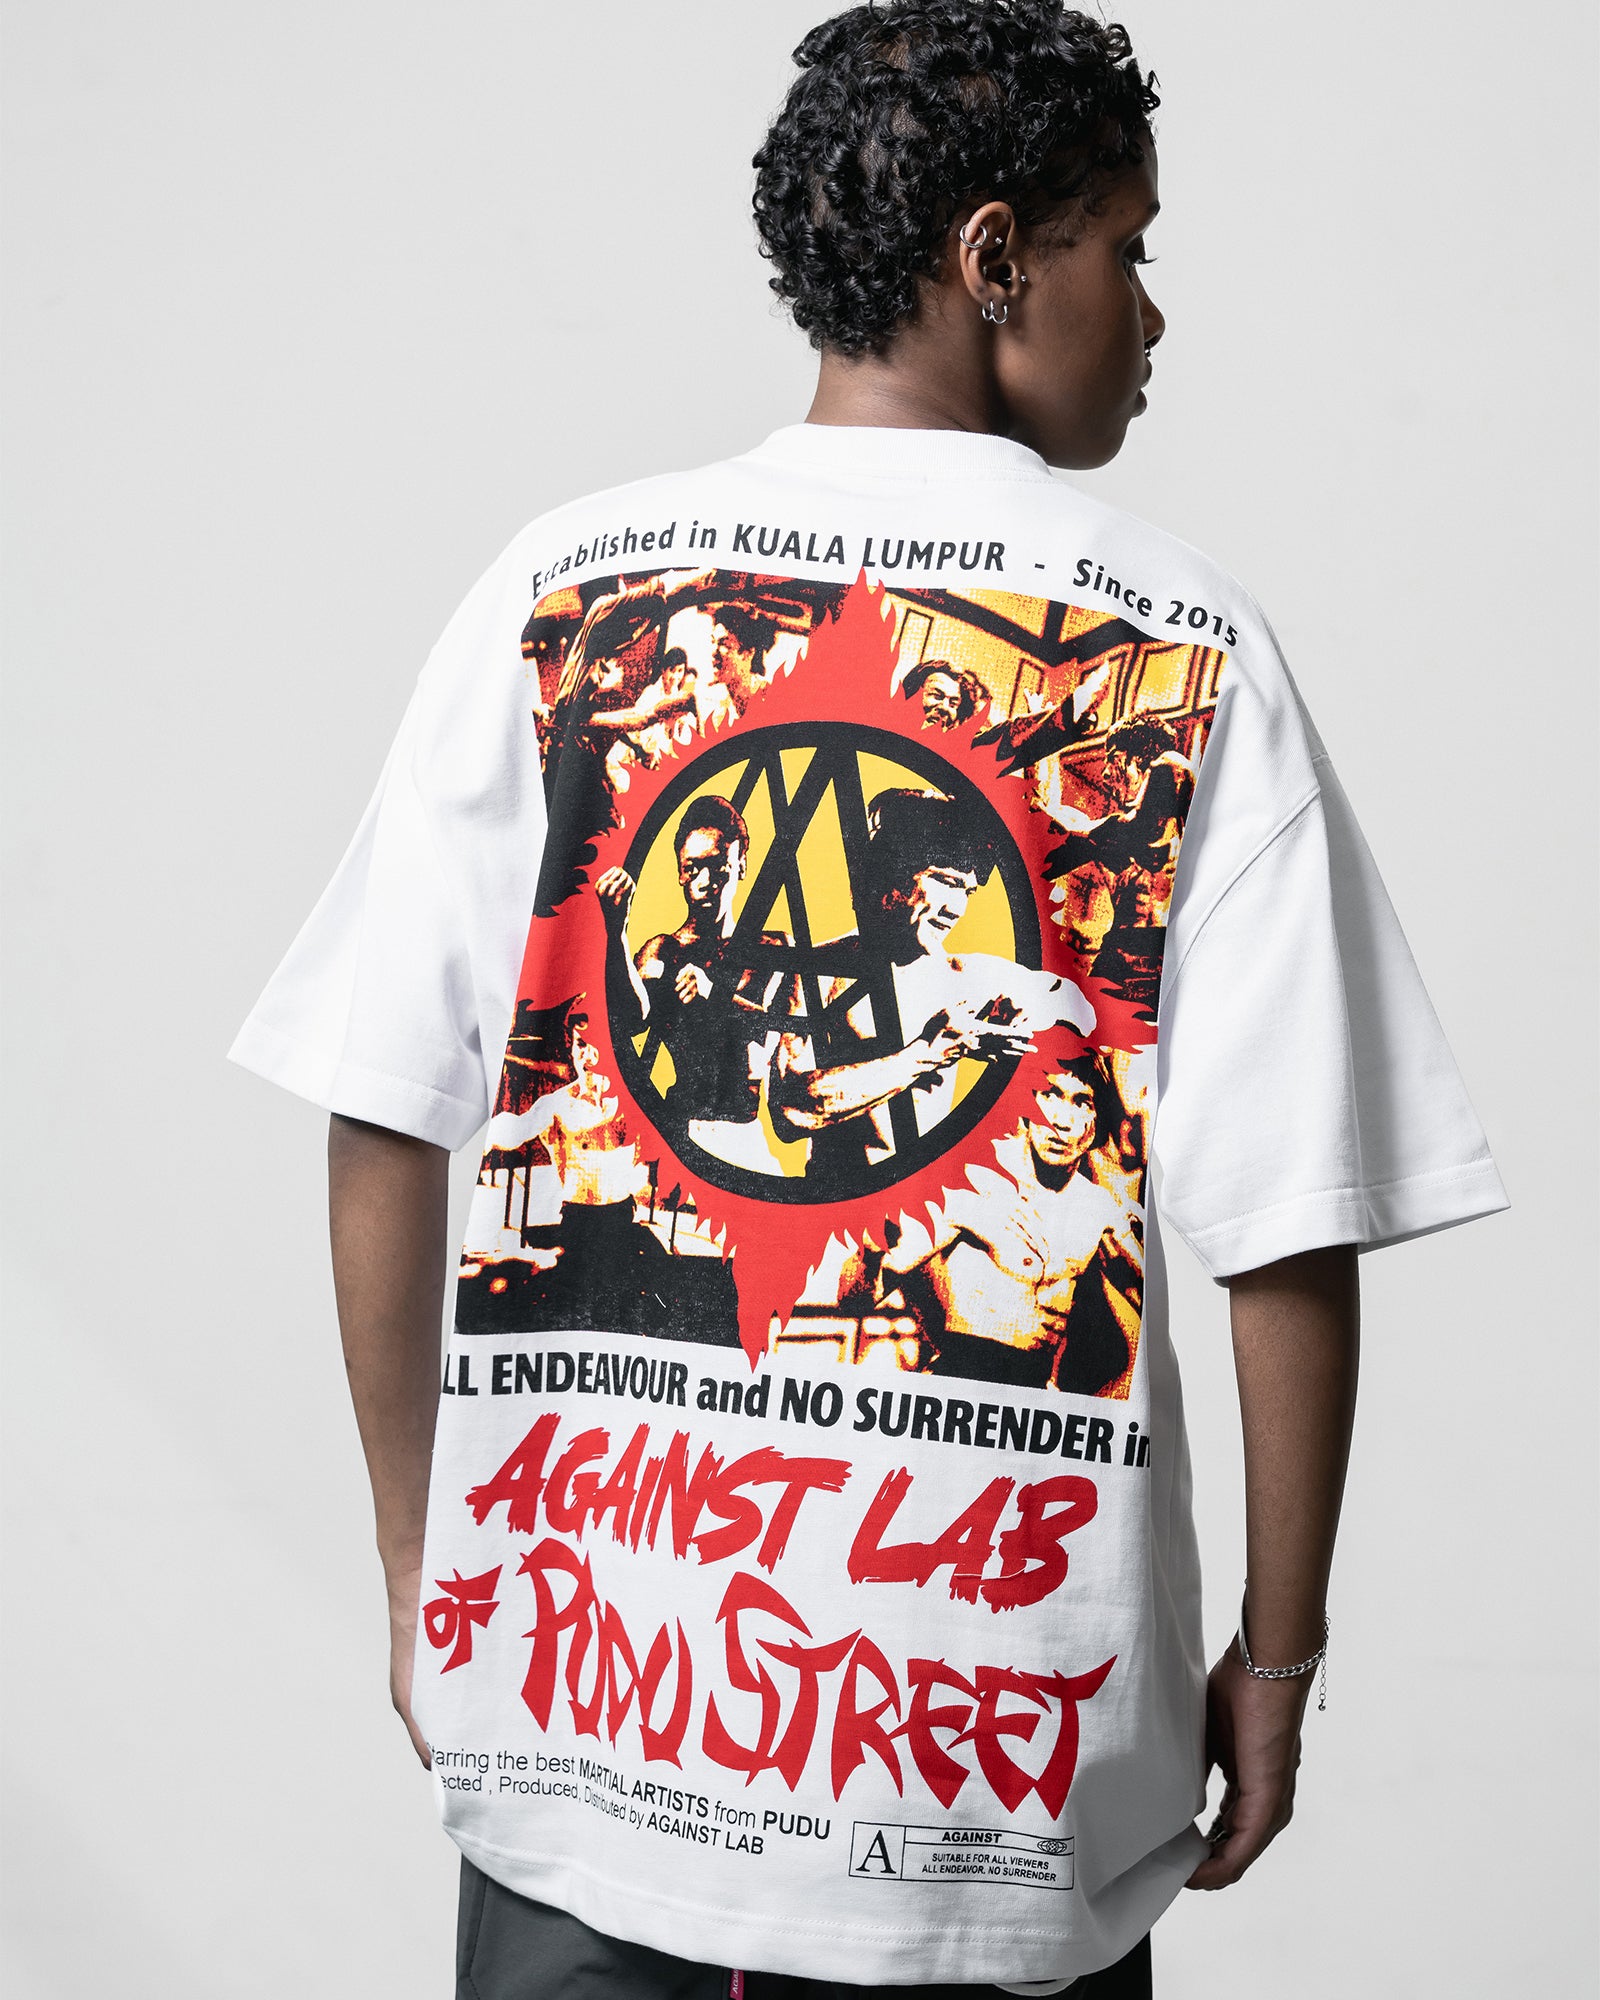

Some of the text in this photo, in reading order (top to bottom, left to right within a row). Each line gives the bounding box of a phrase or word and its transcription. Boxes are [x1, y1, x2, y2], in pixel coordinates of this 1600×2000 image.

[688, 520, 717, 549] in
[733, 523, 845, 565] KUALA
[862, 537, 1005, 572] LUMPUR
[1072, 558, 1152, 617] Since
[1165, 600, 1238, 647] 2015
[491, 1352, 688, 1406] ENDEAVOUR
[696, 1374, 771, 1418] and
[779, 1378, 844, 1427] NO
[852, 1387, 1115, 1463] SURRENDER
[464, 1412, 1099, 1613] AGAINST LAB
[422, 1537, 1118, 1822] OF PUDU STREET
[427, 1742, 831, 1840] tarring the best MARTIAL ARTISTS from PUDU
[499, 1775, 581, 1804] Produced,
[629, 1805, 645, 1830] by
[647, 1811, 721, 1846] AGAINST
[725, 1831, 764, 1855] LAB
[855, 1829, 897, 1875] A
[921, 1864, 938, 1874] ALL
[988, 1866, 1001, 1876] NO
[1002, 1867, 1057, 1882] SURRENDER
[932, 1853, 1050, 1870] SUITABLE FOR ALL VIEWERS
[941, 1831, 1003, 1844] AGAINST
